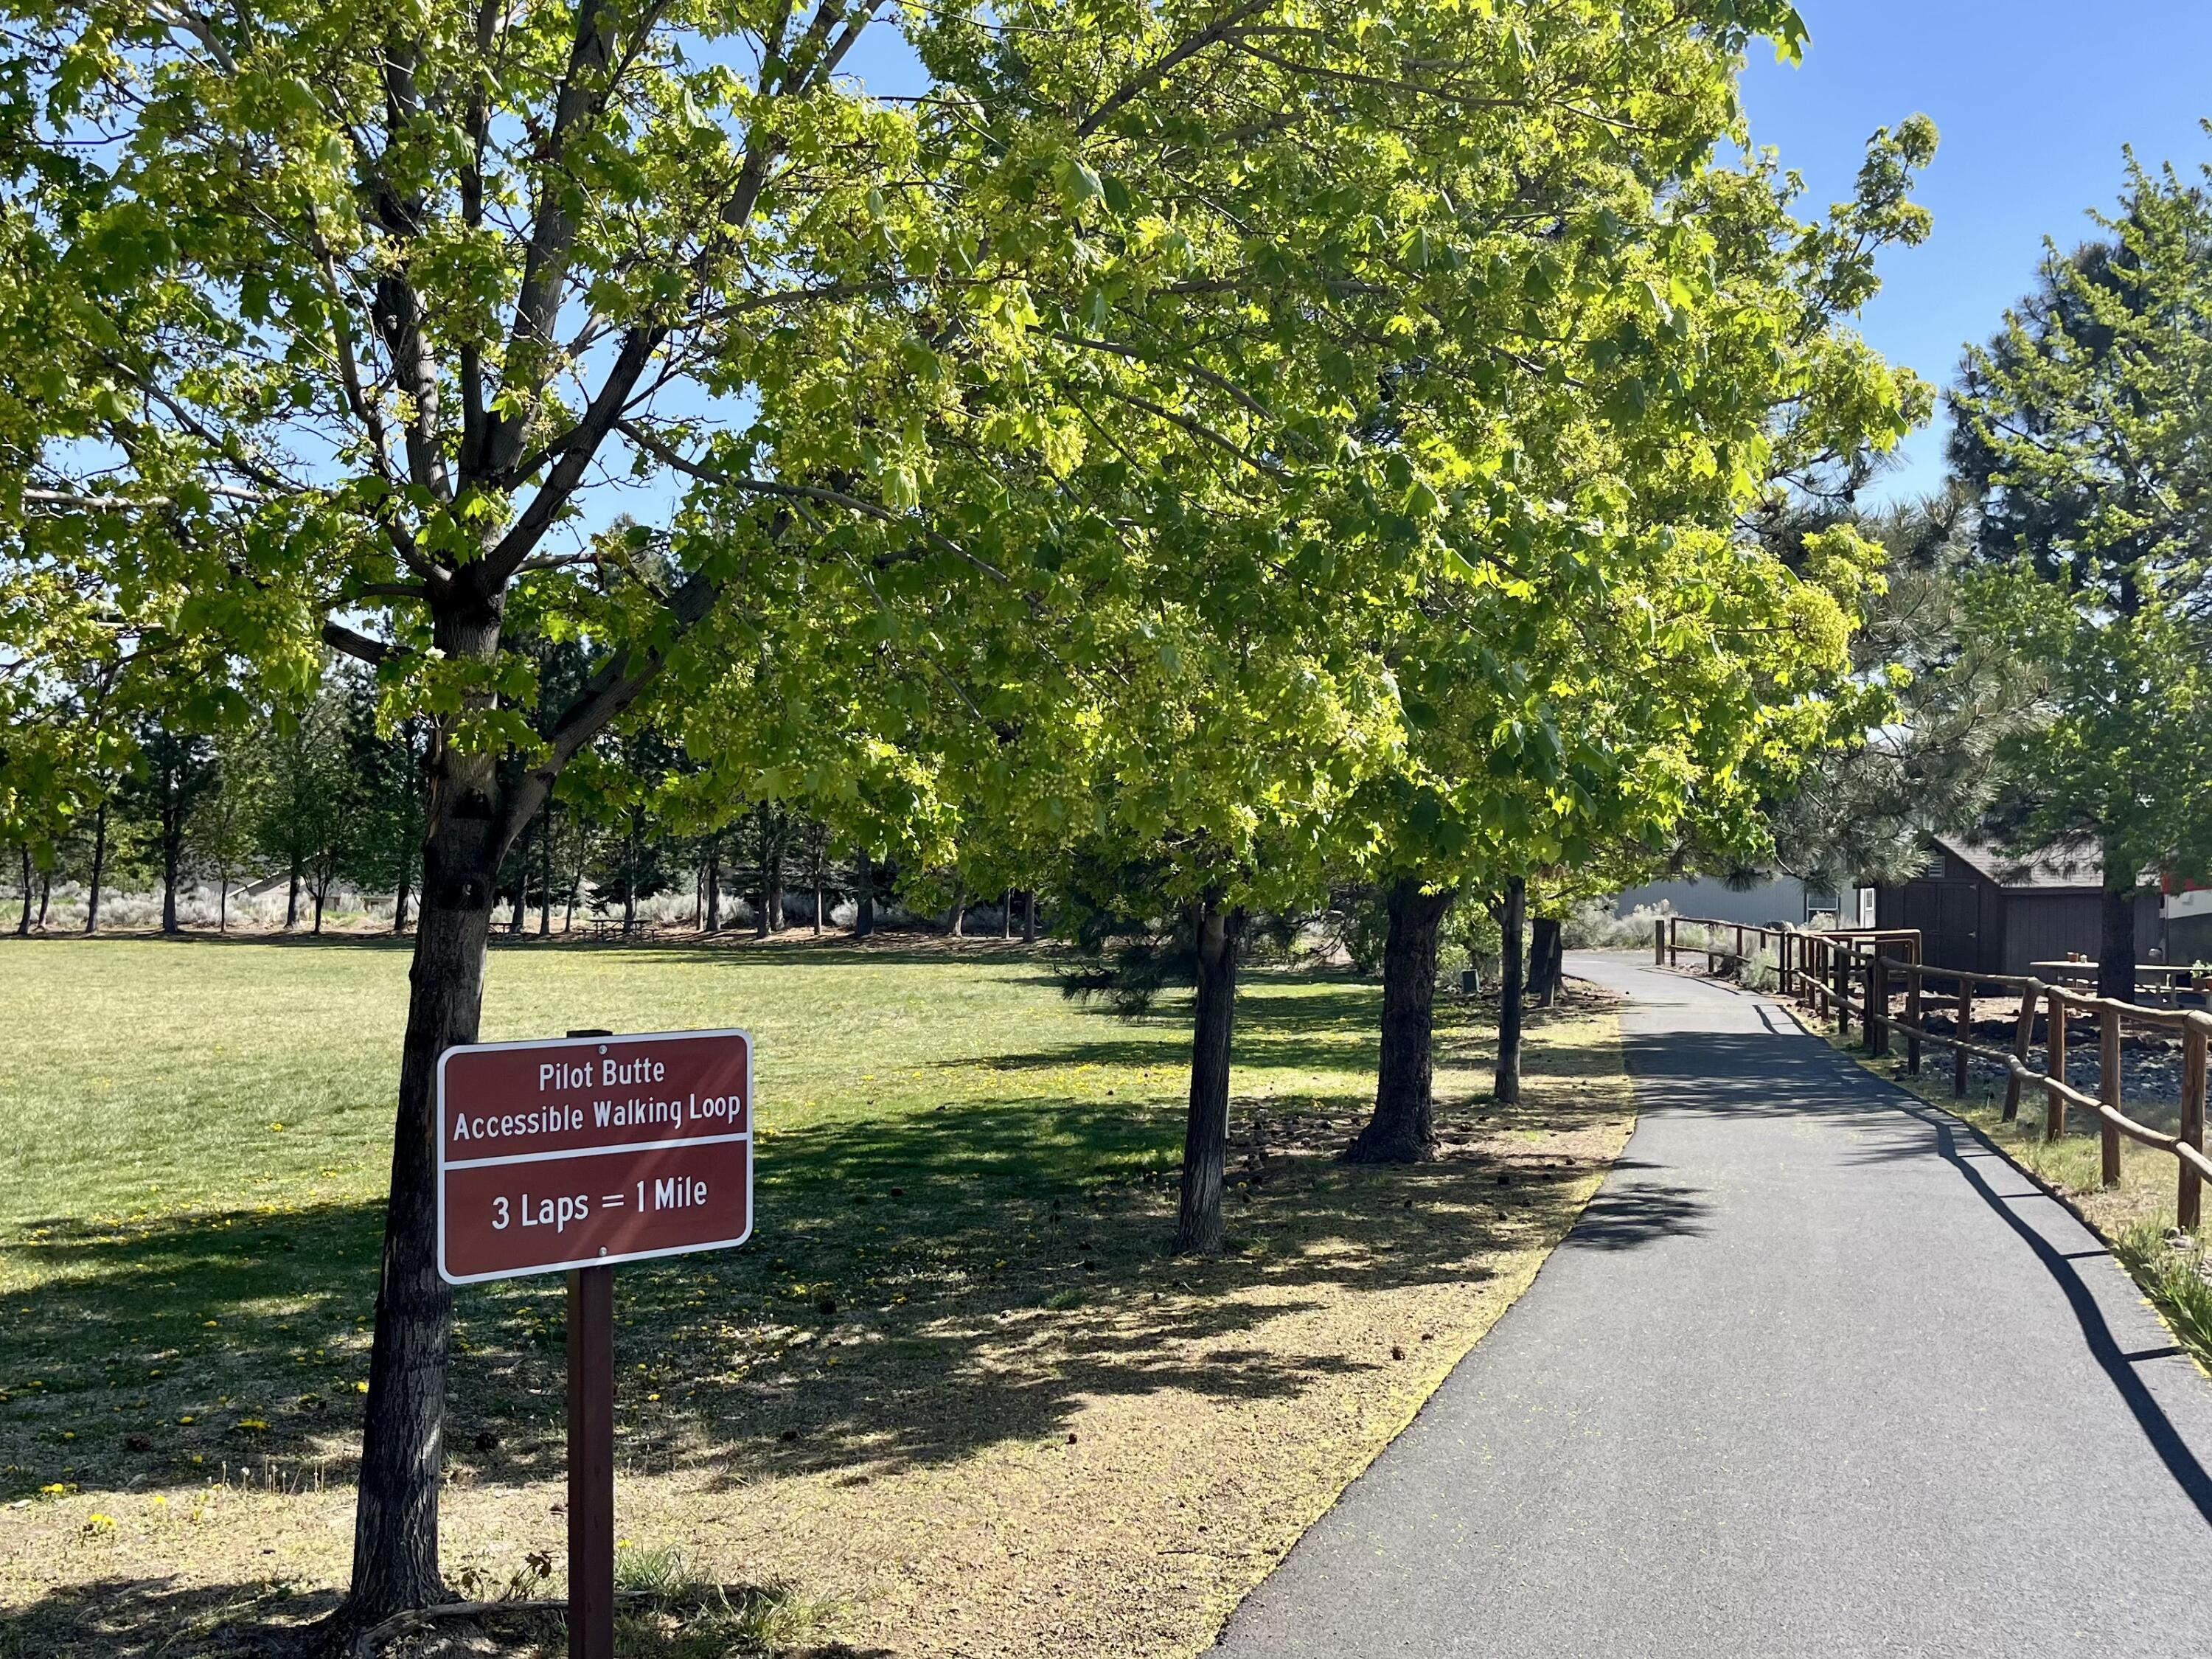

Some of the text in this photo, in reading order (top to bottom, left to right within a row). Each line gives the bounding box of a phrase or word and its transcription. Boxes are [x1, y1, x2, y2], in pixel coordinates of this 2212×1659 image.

[540, 1057, 664, 1091] Pilot Butte
[453, 1093, 740, 1141] Accessible Walking Loop
[492, 1175, 707, 1233] 3 Laps = 1 Mile
